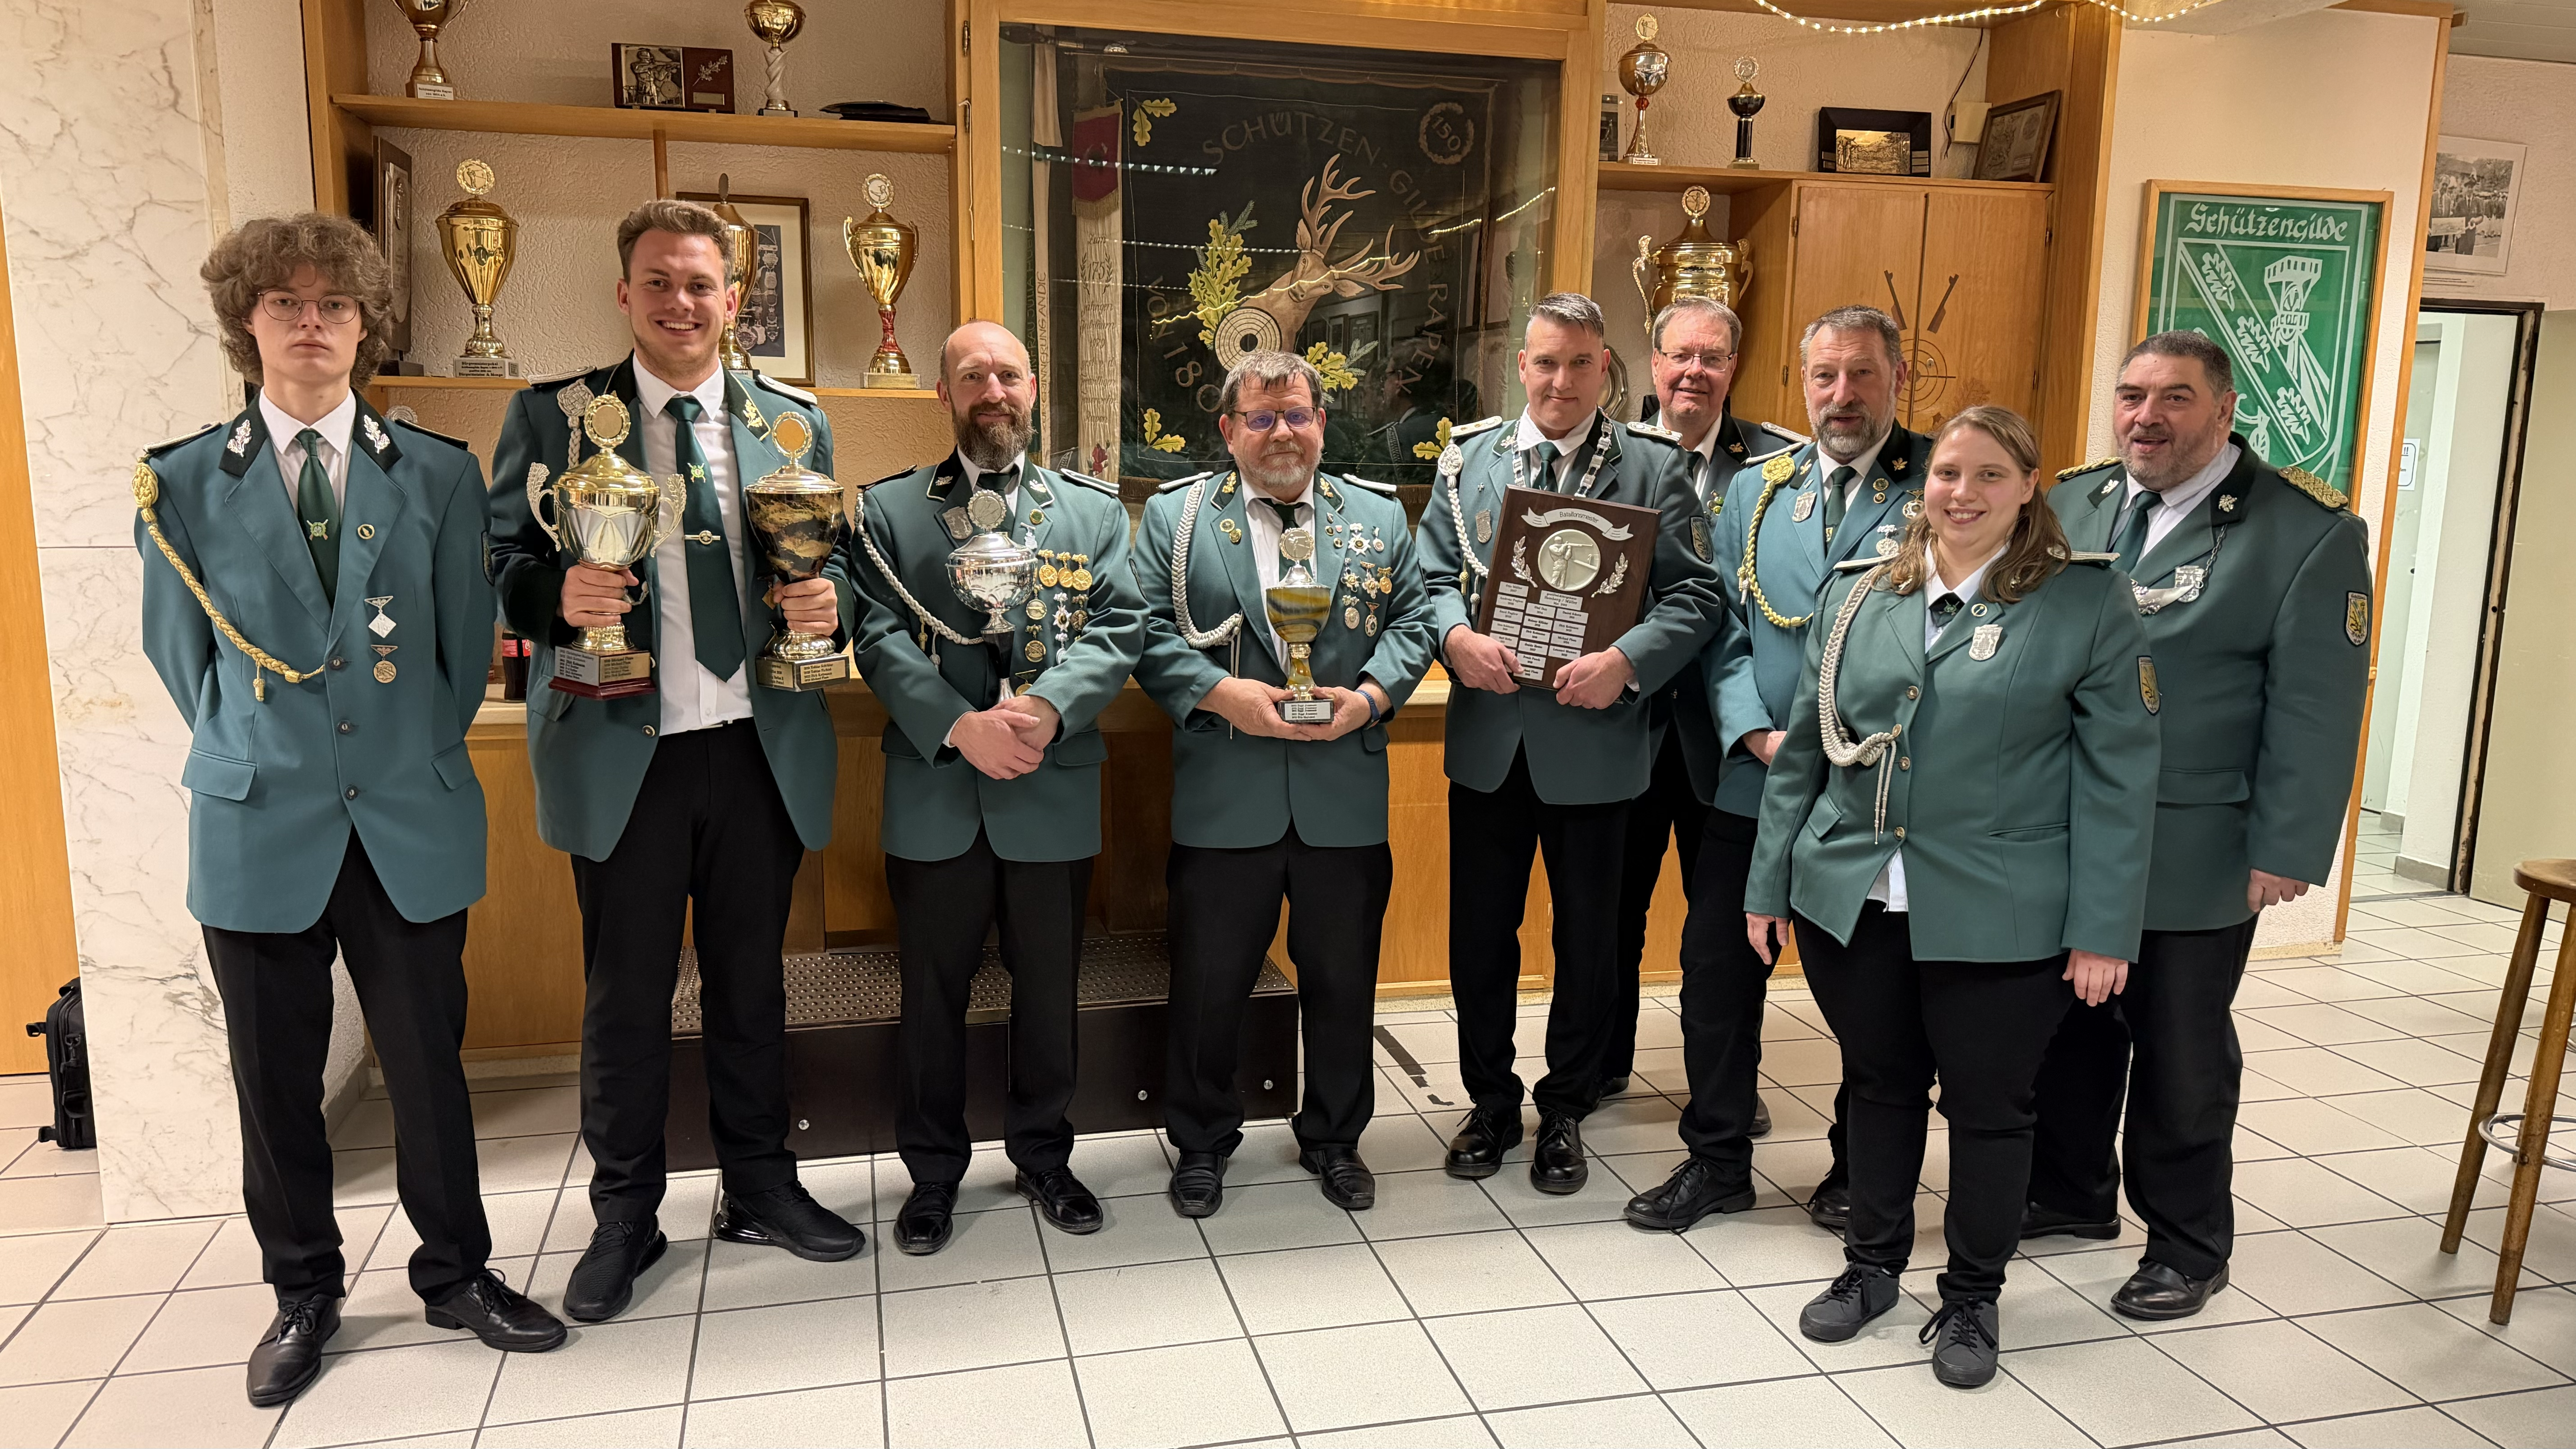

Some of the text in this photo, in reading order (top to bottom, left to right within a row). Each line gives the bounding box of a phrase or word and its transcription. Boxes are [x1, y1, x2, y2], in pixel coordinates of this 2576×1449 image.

[1431, 116, 1462, 152] 150
[2185, 202, 2348, 243] Schützengilde
[1088, 262, 1105, 280] 175
[1164, 342, 1223, 413] 180
